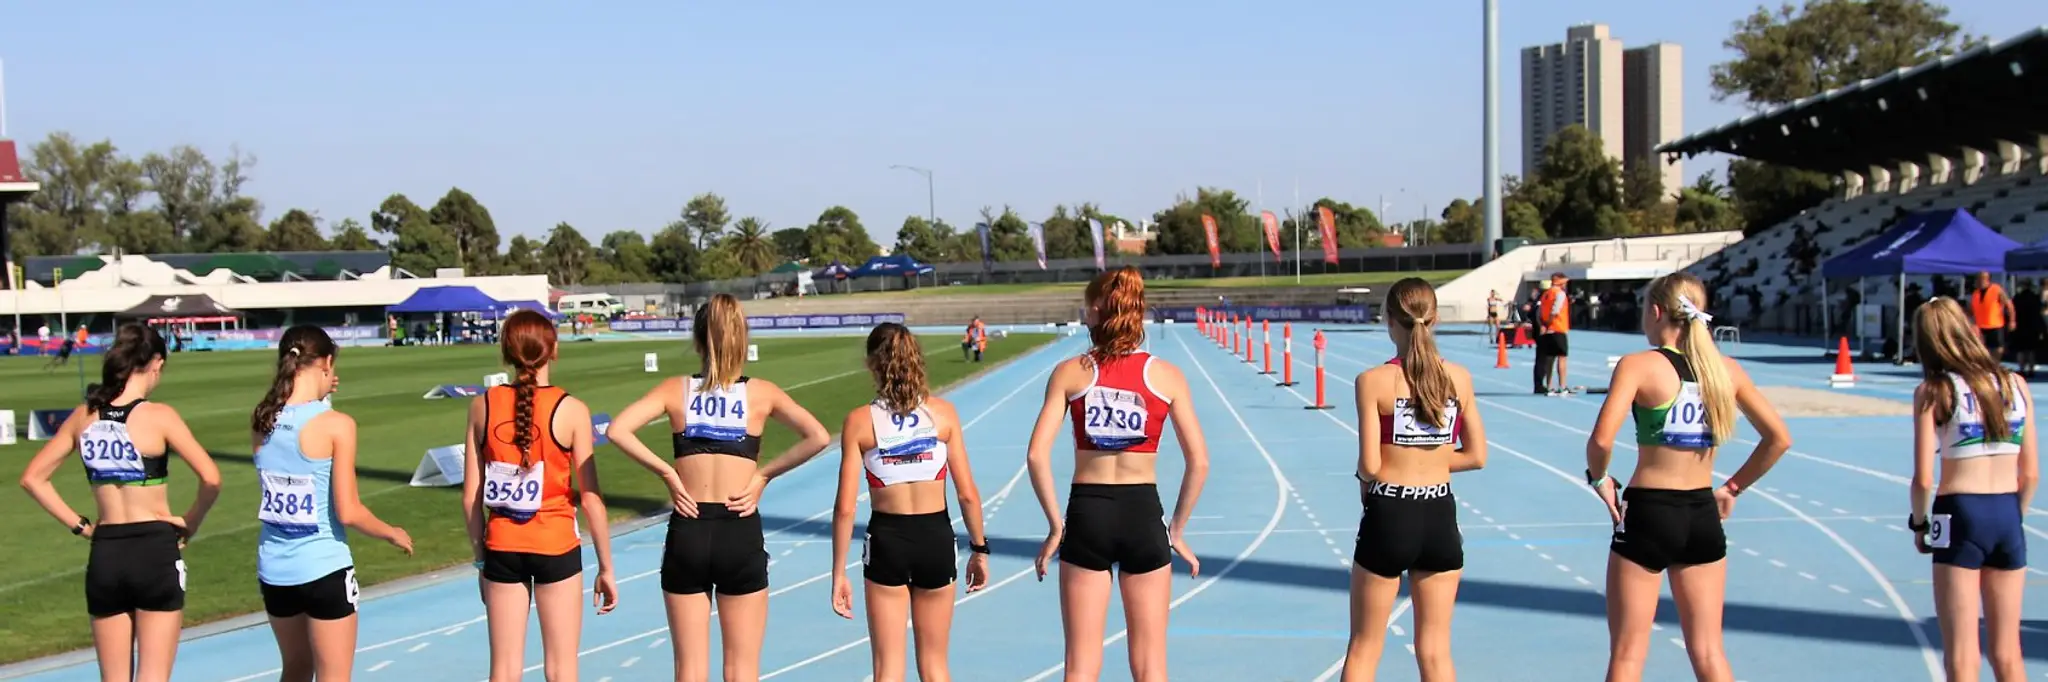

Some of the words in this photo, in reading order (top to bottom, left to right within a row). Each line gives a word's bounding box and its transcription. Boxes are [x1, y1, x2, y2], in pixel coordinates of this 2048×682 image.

[690, 395, 744, 419] 4014
[1088, 405, 1142, 430] 2730
[83, 439, 138, 461] 3203
[263, 489, 314, 516] 2584
[486, 480, 539, 502] 3569
